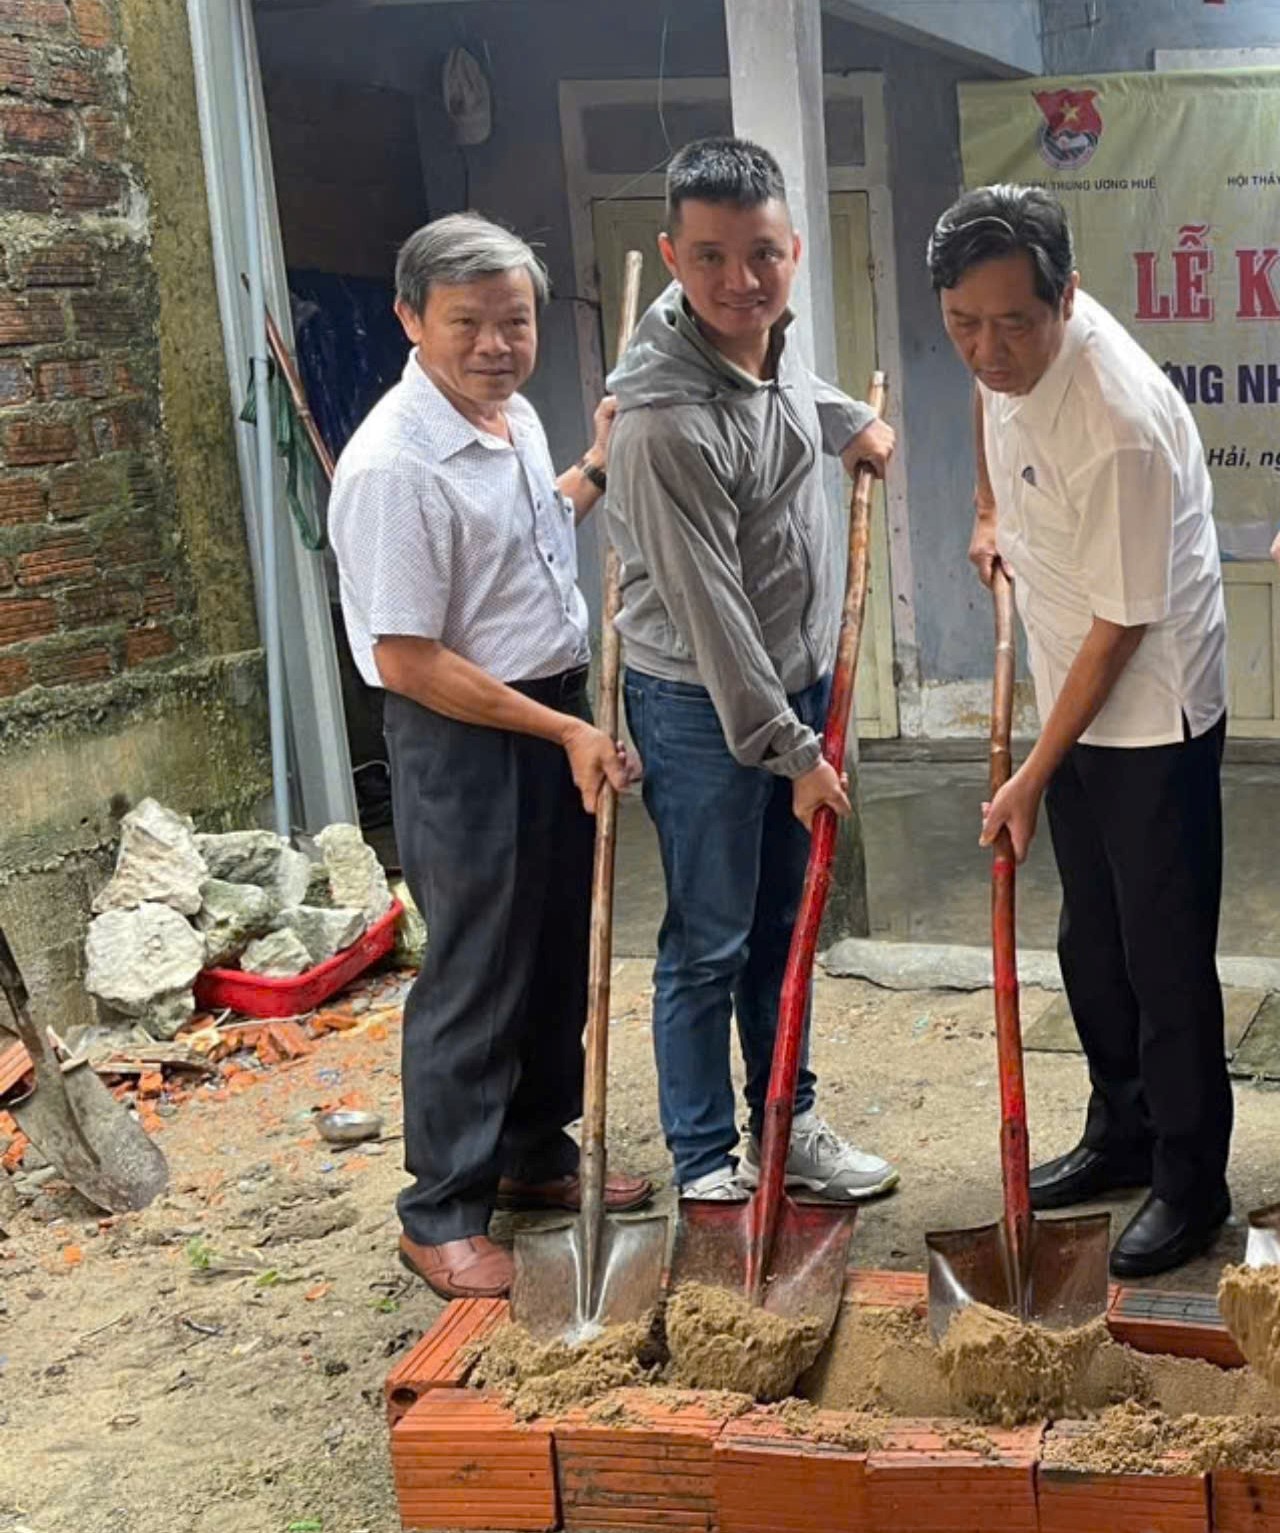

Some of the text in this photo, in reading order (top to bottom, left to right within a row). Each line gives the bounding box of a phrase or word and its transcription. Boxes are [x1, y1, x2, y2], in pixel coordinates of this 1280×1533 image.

[1131, 176, 1157, 190] HUẾ
[1227, 172, 1249, 187] HỘI
[1135, 224, 1214, 322] LỄ
[1207, 445, 1251, 469] Hải,
